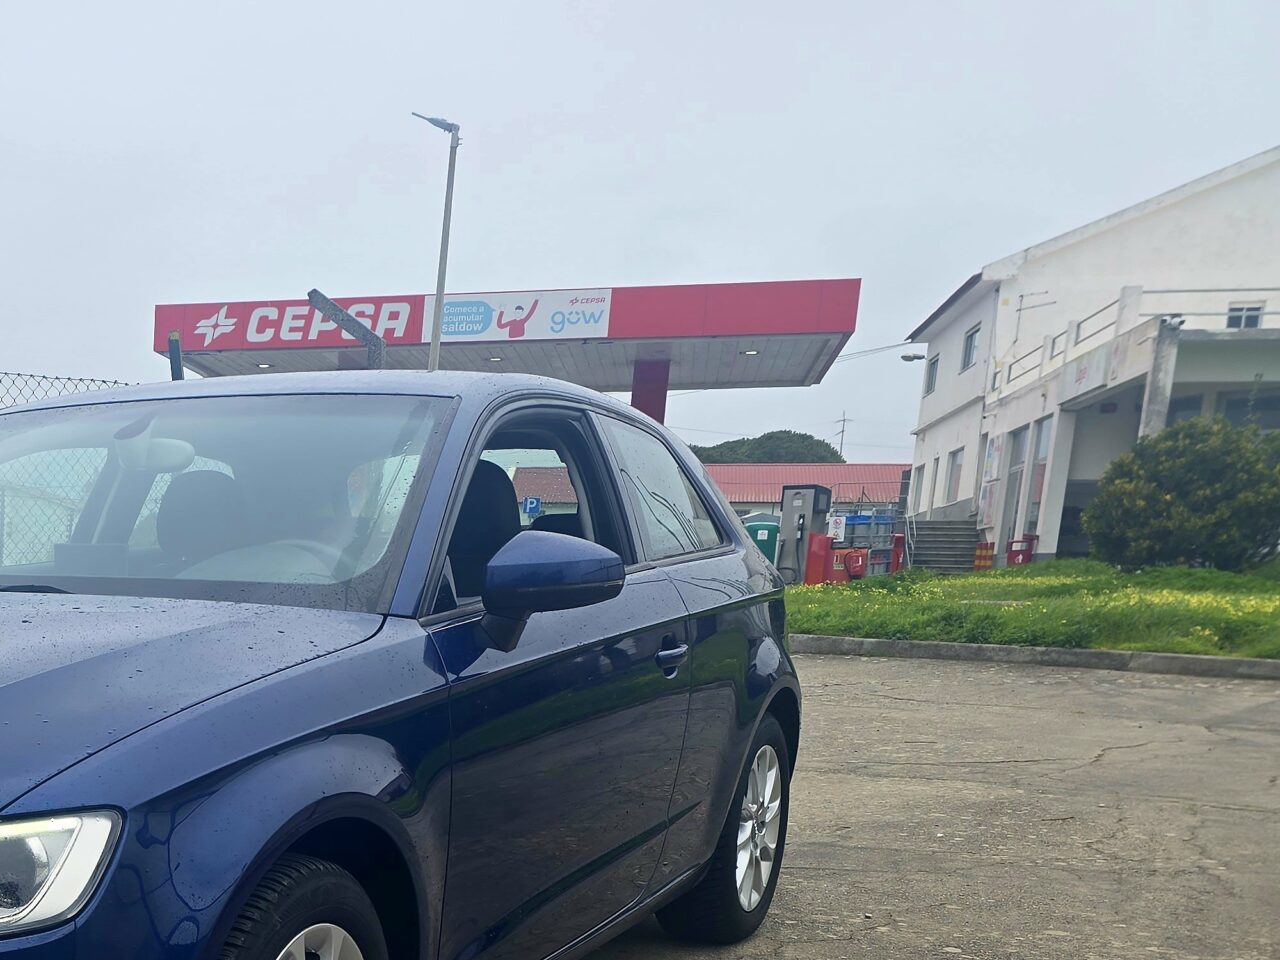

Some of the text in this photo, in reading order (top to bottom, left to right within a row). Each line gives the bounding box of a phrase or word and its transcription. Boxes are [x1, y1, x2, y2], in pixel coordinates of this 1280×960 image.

[443, 305, 478, 314] Comece
[246, 302, 411, 343] CEPSA
[443, 314, 484, 322] acumular
[441, 322, 484, 332] saldow
[526, 498, 537, 512] P
